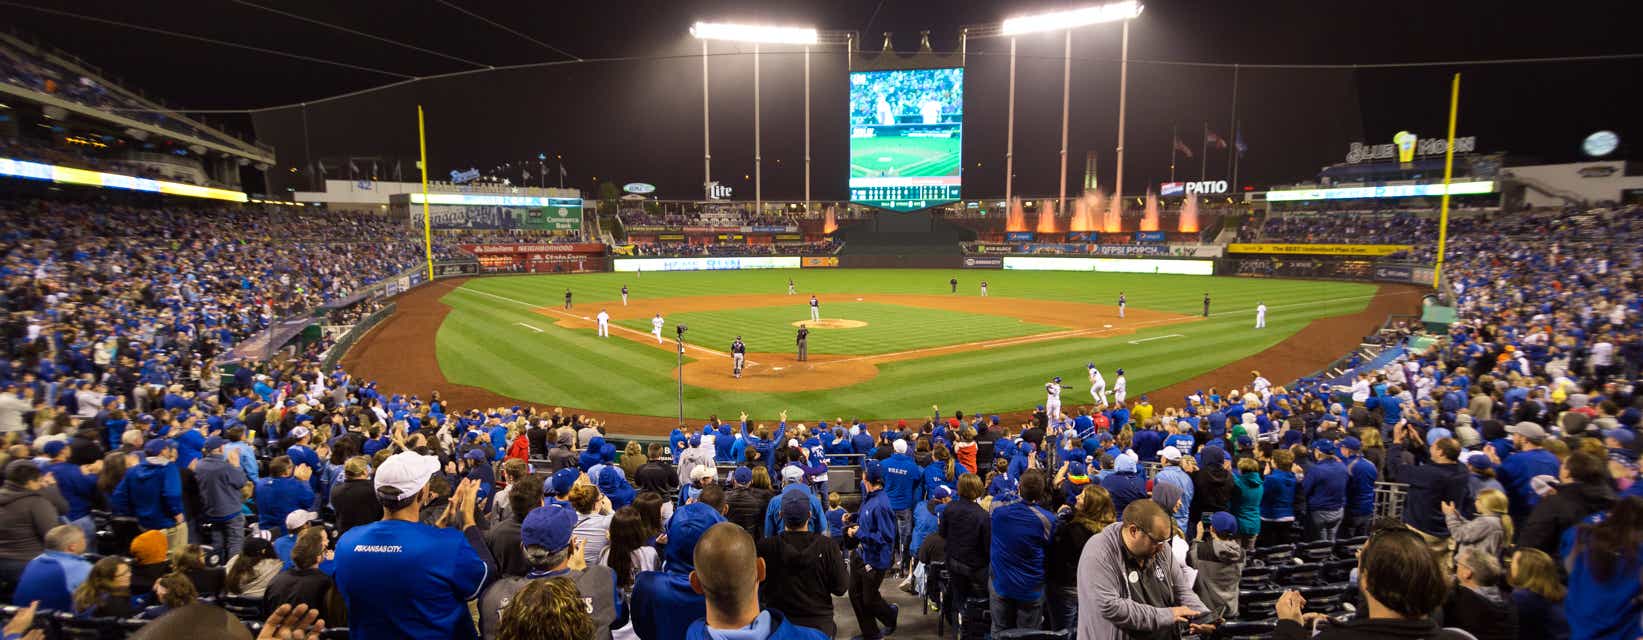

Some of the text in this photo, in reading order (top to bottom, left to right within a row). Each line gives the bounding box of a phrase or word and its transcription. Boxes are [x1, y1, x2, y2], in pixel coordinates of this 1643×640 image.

[1346, 142, 1394, 164] BLUE
[708, 181, 733, 199] Lite
[1185, 180, 1228, 194] PATIO
